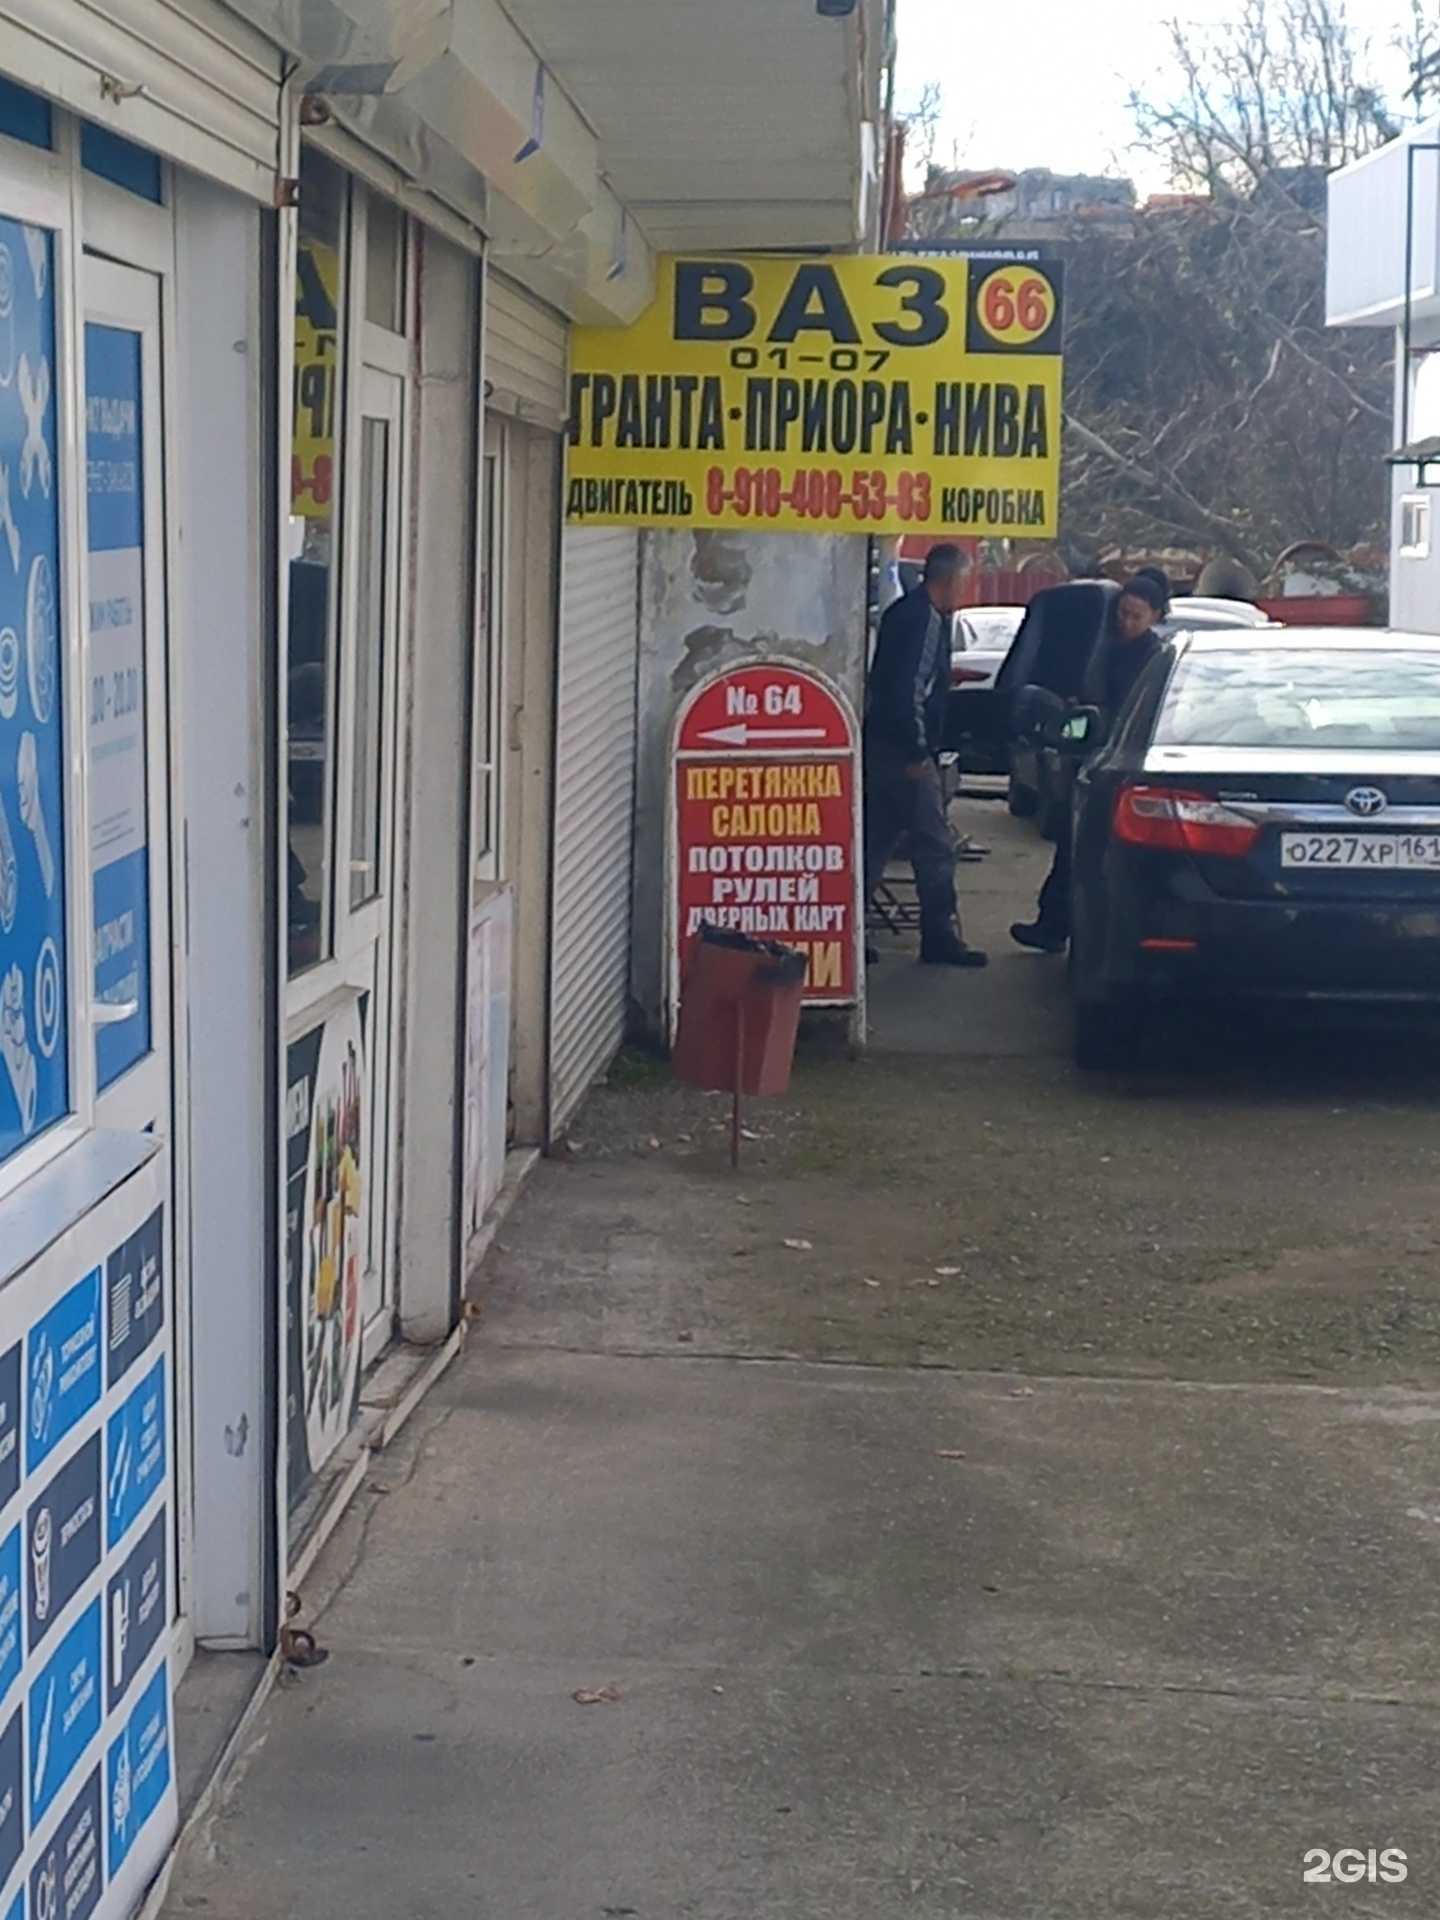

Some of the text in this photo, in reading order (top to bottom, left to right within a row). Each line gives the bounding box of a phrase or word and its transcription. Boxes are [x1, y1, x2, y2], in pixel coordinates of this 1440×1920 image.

[673, 260, 949, 347] ВАЗ
[984, 278, 1047, 331] 66
[730, 347, 890, 372] 01-07
[564, 373, 1048, 458] ГРАНТА ПРИОРА НИВА
[566, 478, 693, 520] ДВИГАТЕЛЬ
[941, 487, 1045, 525] КОРОБКА
[764, 685, 802, 716] 64
[687, 765, 842, 801] ПЕРЕТЯЖКА
[712, 803, 821, 838] САЛОНА
[688, 845, 843, 873] ПОТОЛКОВ
[1400, 837, 1440, 858] 161
[712, 874, 819, 903] РУЛЕЙ
[794, 904, 846, 932] КАРТ
